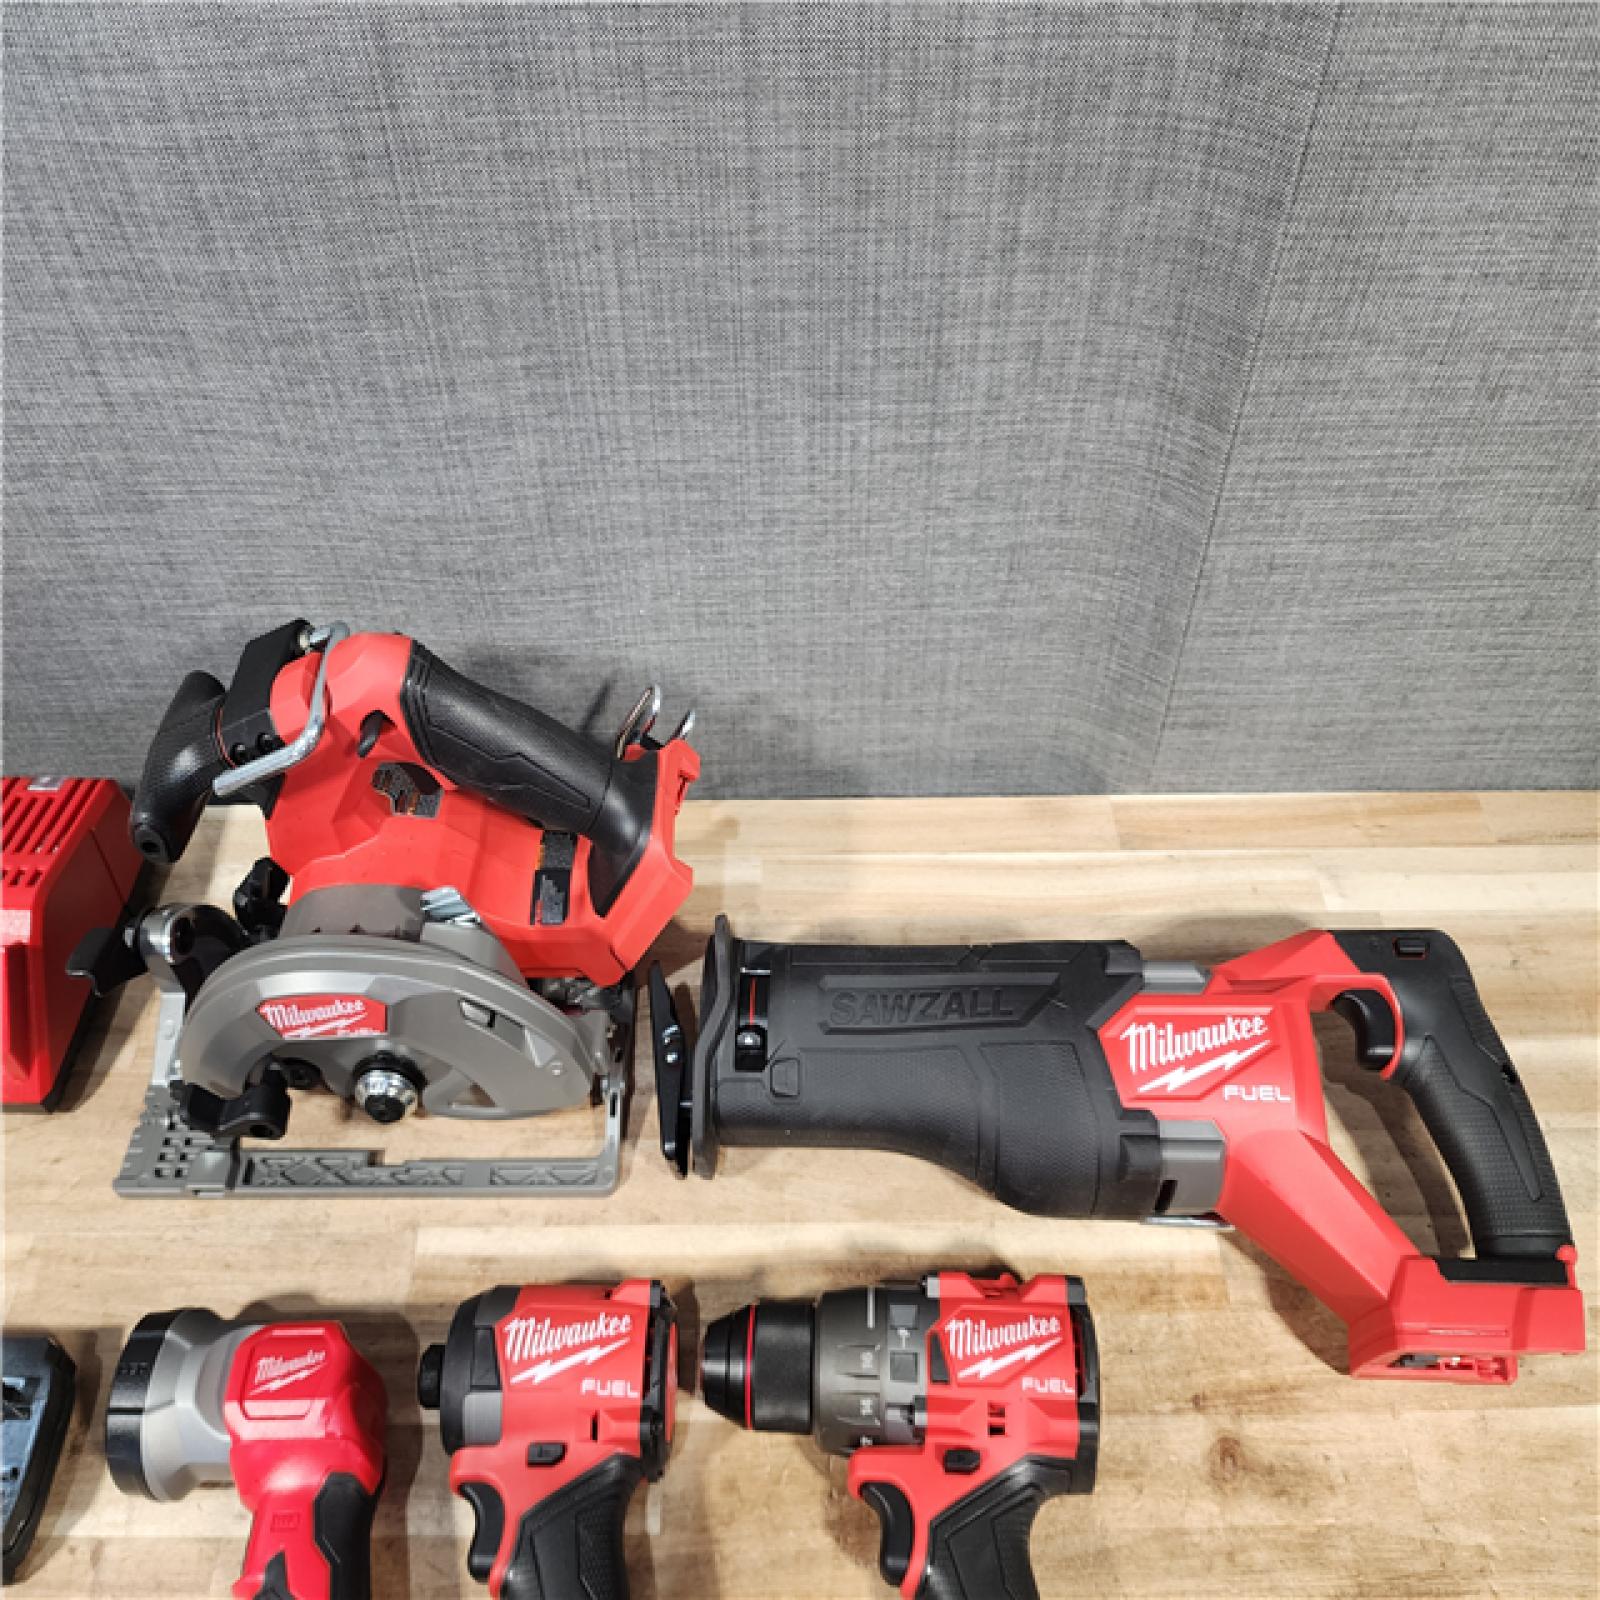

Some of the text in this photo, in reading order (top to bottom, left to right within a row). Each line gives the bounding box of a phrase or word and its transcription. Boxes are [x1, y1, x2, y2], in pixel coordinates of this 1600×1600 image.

[260, 1000, 366, 1029] Milwaukee
[829, 988, 1014, 1026] SAWZALL
[1120, 1015, 1269, 1075] Milwaukee
[1223, 1084, 1292, 1101] FUEL
[504, 1312, 632, 1364] Milwaukee
[945, 1315, 1061, 1360] Milwaukee
[255, 1350, 327, 1385] Milwaukee
[1021, 1377, 1075, 1393] FUEL
[581, 1378, 639, 1398] FUEL
